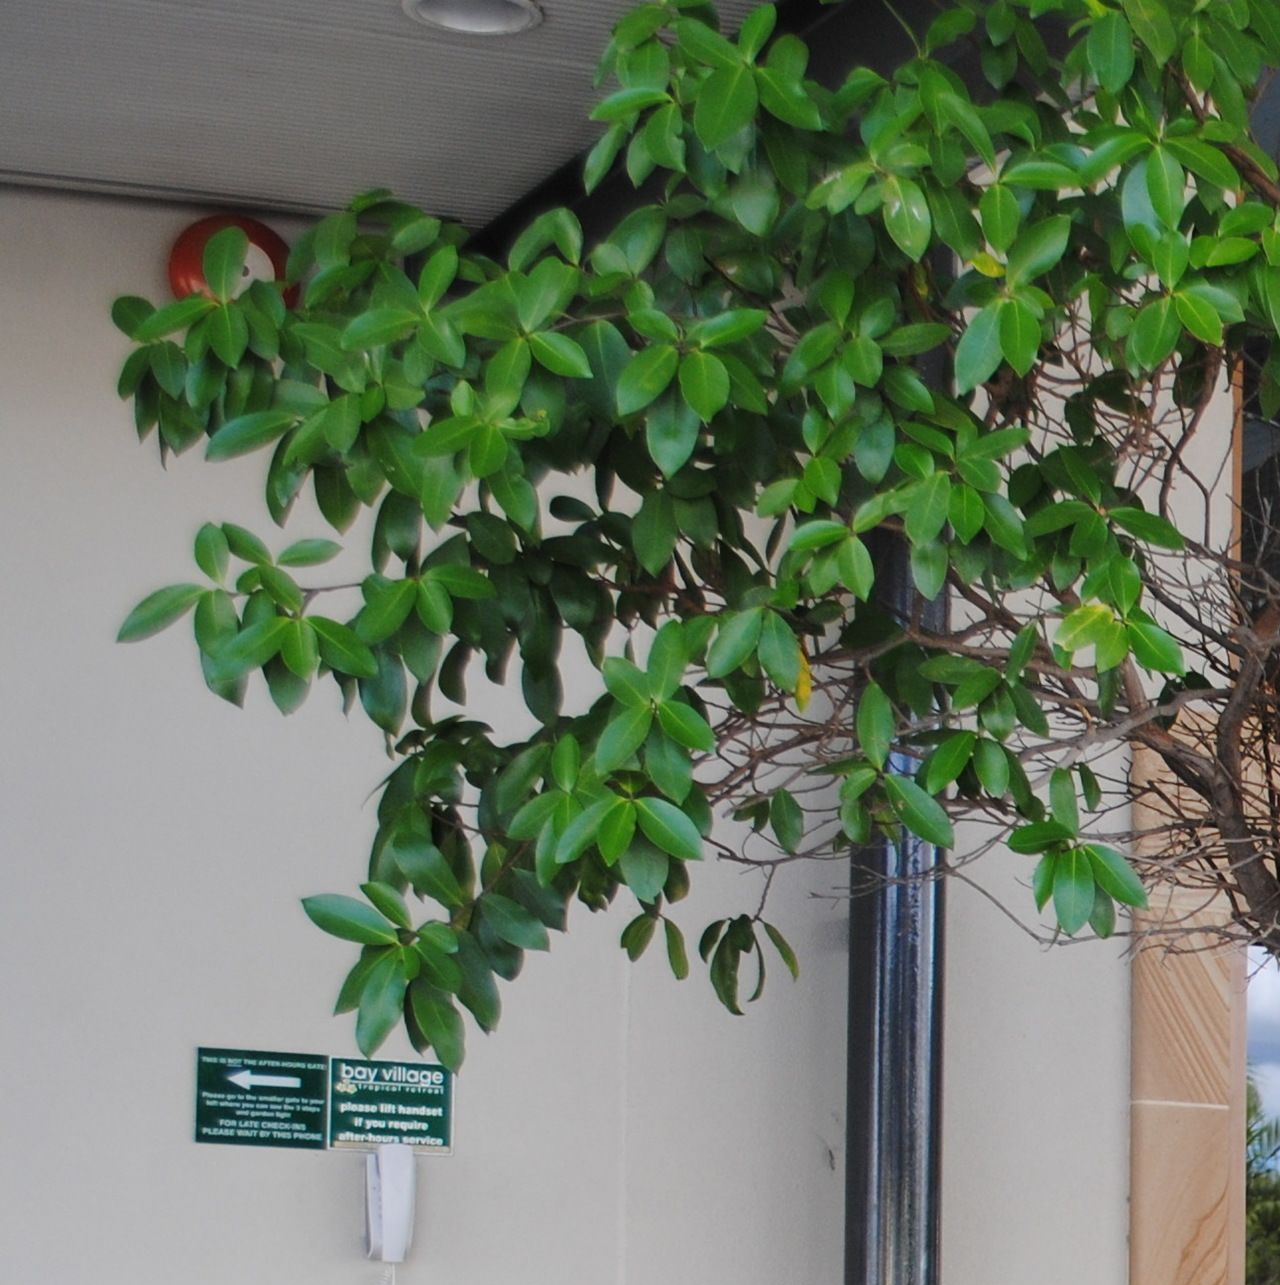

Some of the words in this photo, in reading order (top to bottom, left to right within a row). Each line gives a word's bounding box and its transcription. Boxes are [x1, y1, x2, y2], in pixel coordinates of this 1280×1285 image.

[227, 1057, 243, 1065] NOT
[258, 1060, 306, 1069] AFTER-HOURS
[341, 1063, 378, 1083] bay
[382, 1065, 444, 1086] village
[202, 1091, 226, 1099] Please
[357, 1083, 402, 1092] tropical
[405, 1086, 444, 1095] retreat
[242, 1102, 255, 1110] you
[339, 1102, 378, 1114] please
[379, 1103, 396, 1114] lift
[398, 1104, 443, 1117] handset
[219, 1119, 237, 1127] FOR
[238, 1120, 260, 1129] LATE
[261, 1121, 307, 1131] CHECK-INS
[353, 1116, 364, 1127] if
[364, 1118, 386, 1130] you
[387, 1119, 429, 1132] require
[202, 1127, 235, 1136] PLEASE
[236, 1129, 258, 1138] WAIT
[259, 1130, 271, 1138] BY
[271, 1131, 292, 1140] THIS
[293, 1132, 323, 1141] PHONE
[338, 1131, 400, 1144] after-hours
[402, 1135, 444, 1146] service
